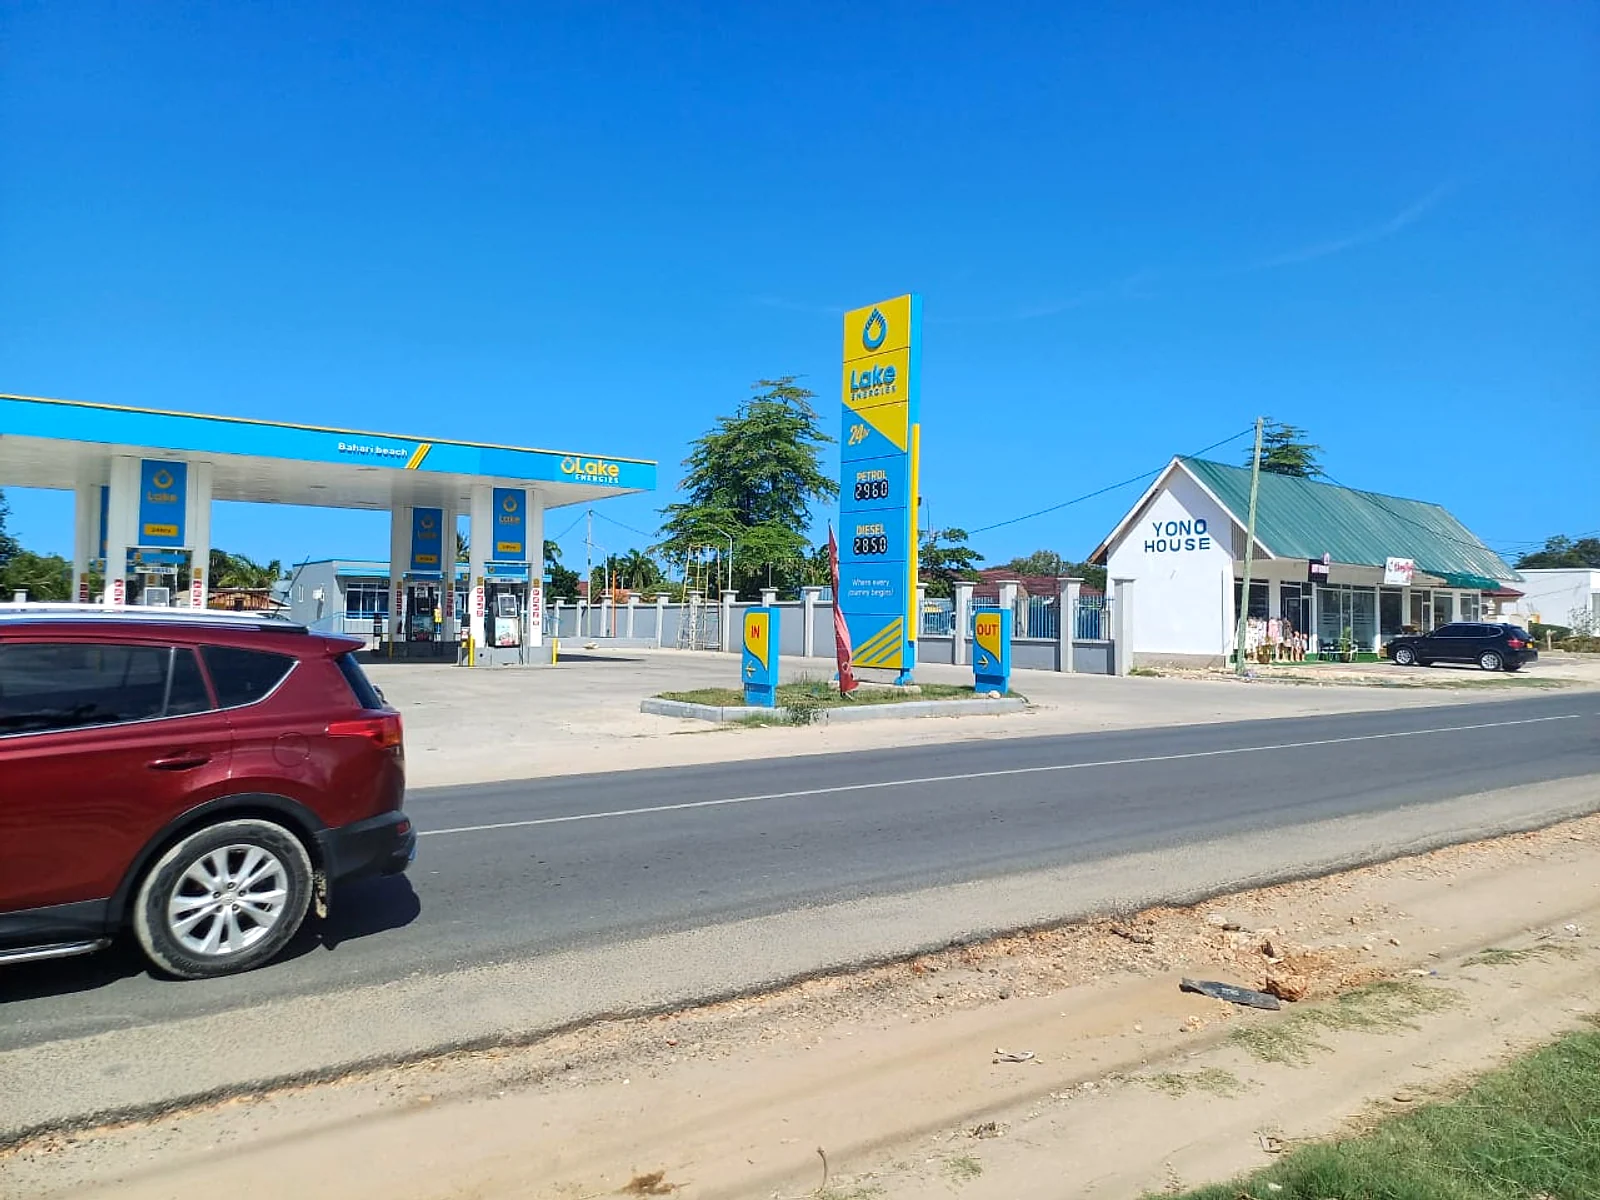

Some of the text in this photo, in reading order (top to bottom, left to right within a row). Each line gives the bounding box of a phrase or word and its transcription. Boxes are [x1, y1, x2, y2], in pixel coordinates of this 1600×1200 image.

[850, 365, 896, 390] Lake
[851, 386, 896, 401] ENERGIES
[338, 442, 408, 457] Bahari beach
[575, 457, 619, 477] Lake
[575, 473, 619, 484] ENERGIES
[857, 470, 886, 482] PETROL
[855, 481, 888, 499] 2960
[857, 524, 885, 536] DIESEL
[1152, 518, 1207, 538] YONO
[854, 537, 886, 554] 2850
[1144, 537, 1210, 553] HOUSE
[751, 624, 760, 639] IN
[977, 624, 999, 636] OUT
